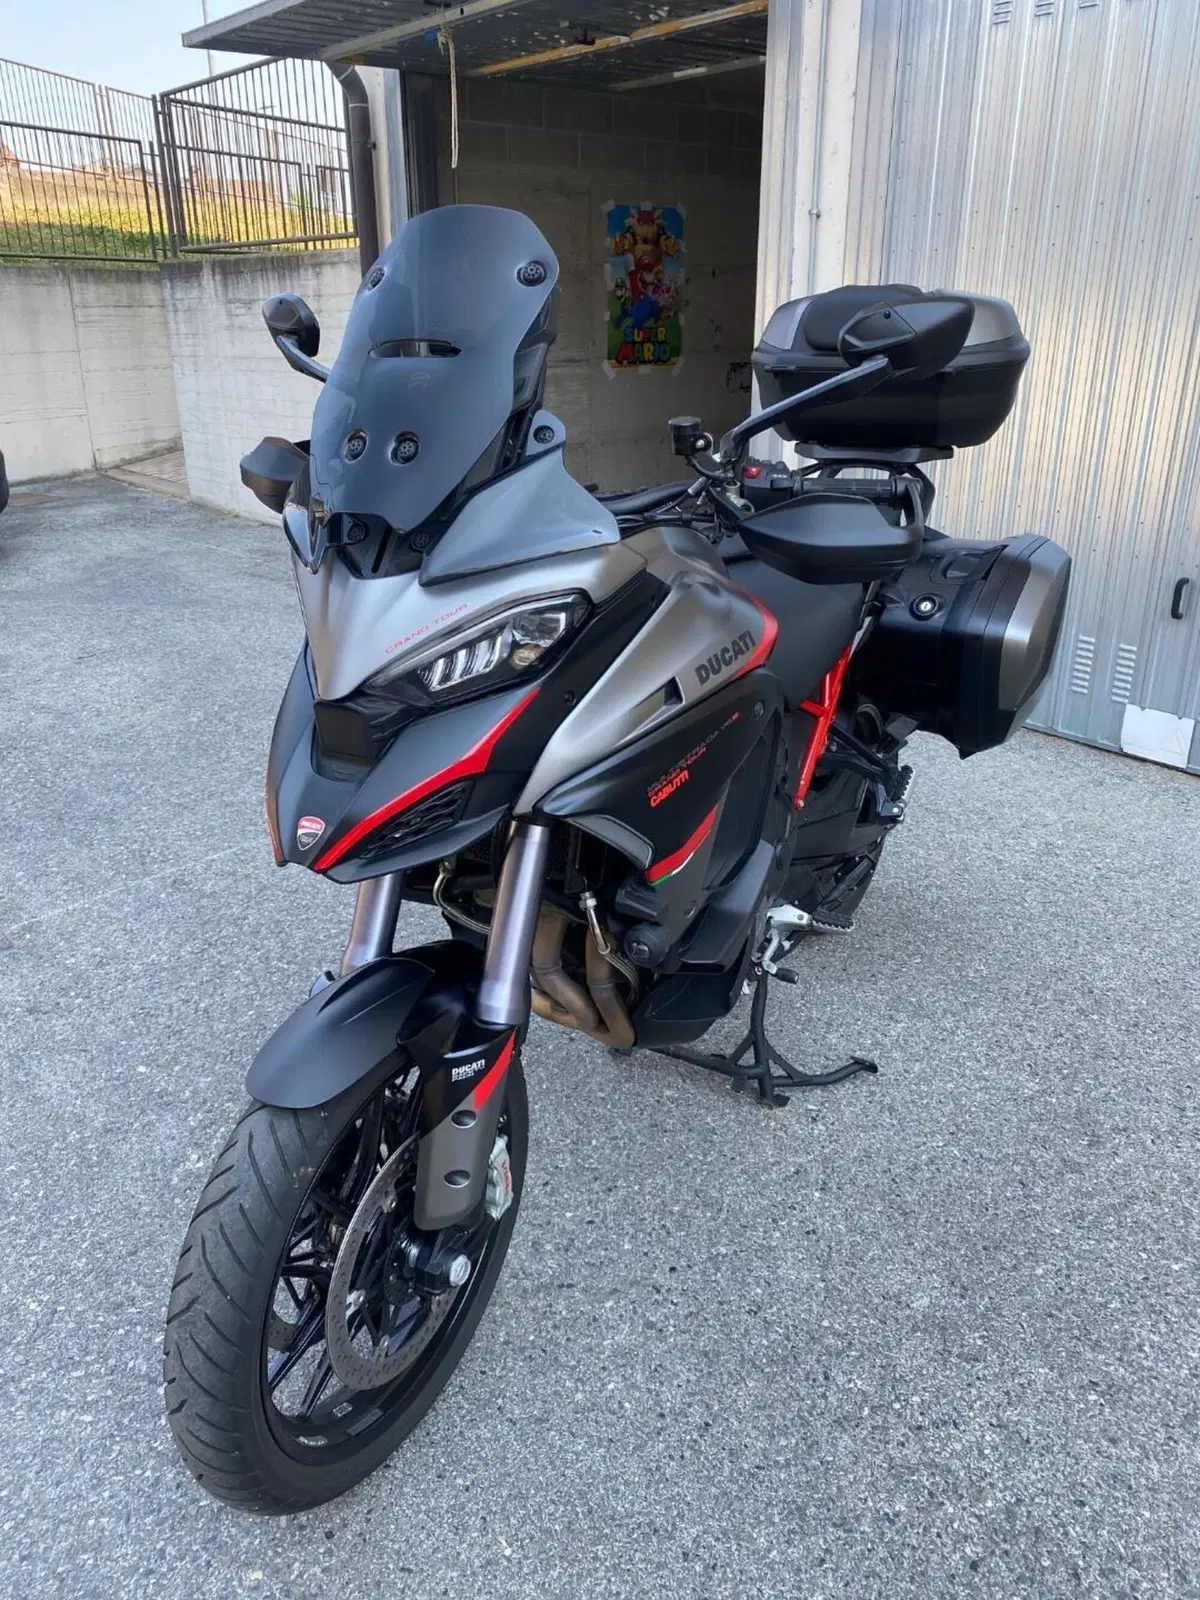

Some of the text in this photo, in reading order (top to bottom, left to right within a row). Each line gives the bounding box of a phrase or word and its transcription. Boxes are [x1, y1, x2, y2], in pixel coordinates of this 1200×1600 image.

[624, 326, 667, 344] SUPER
[616, 341, 671, 364] MARIO
[384, 603, 468, 655] GRAND TOUR
[694, 630, 757, 686] DUCATI
[650, 769, 689, 808] CABUTTI
[451, 1059, 485, 1075] DUCATI
